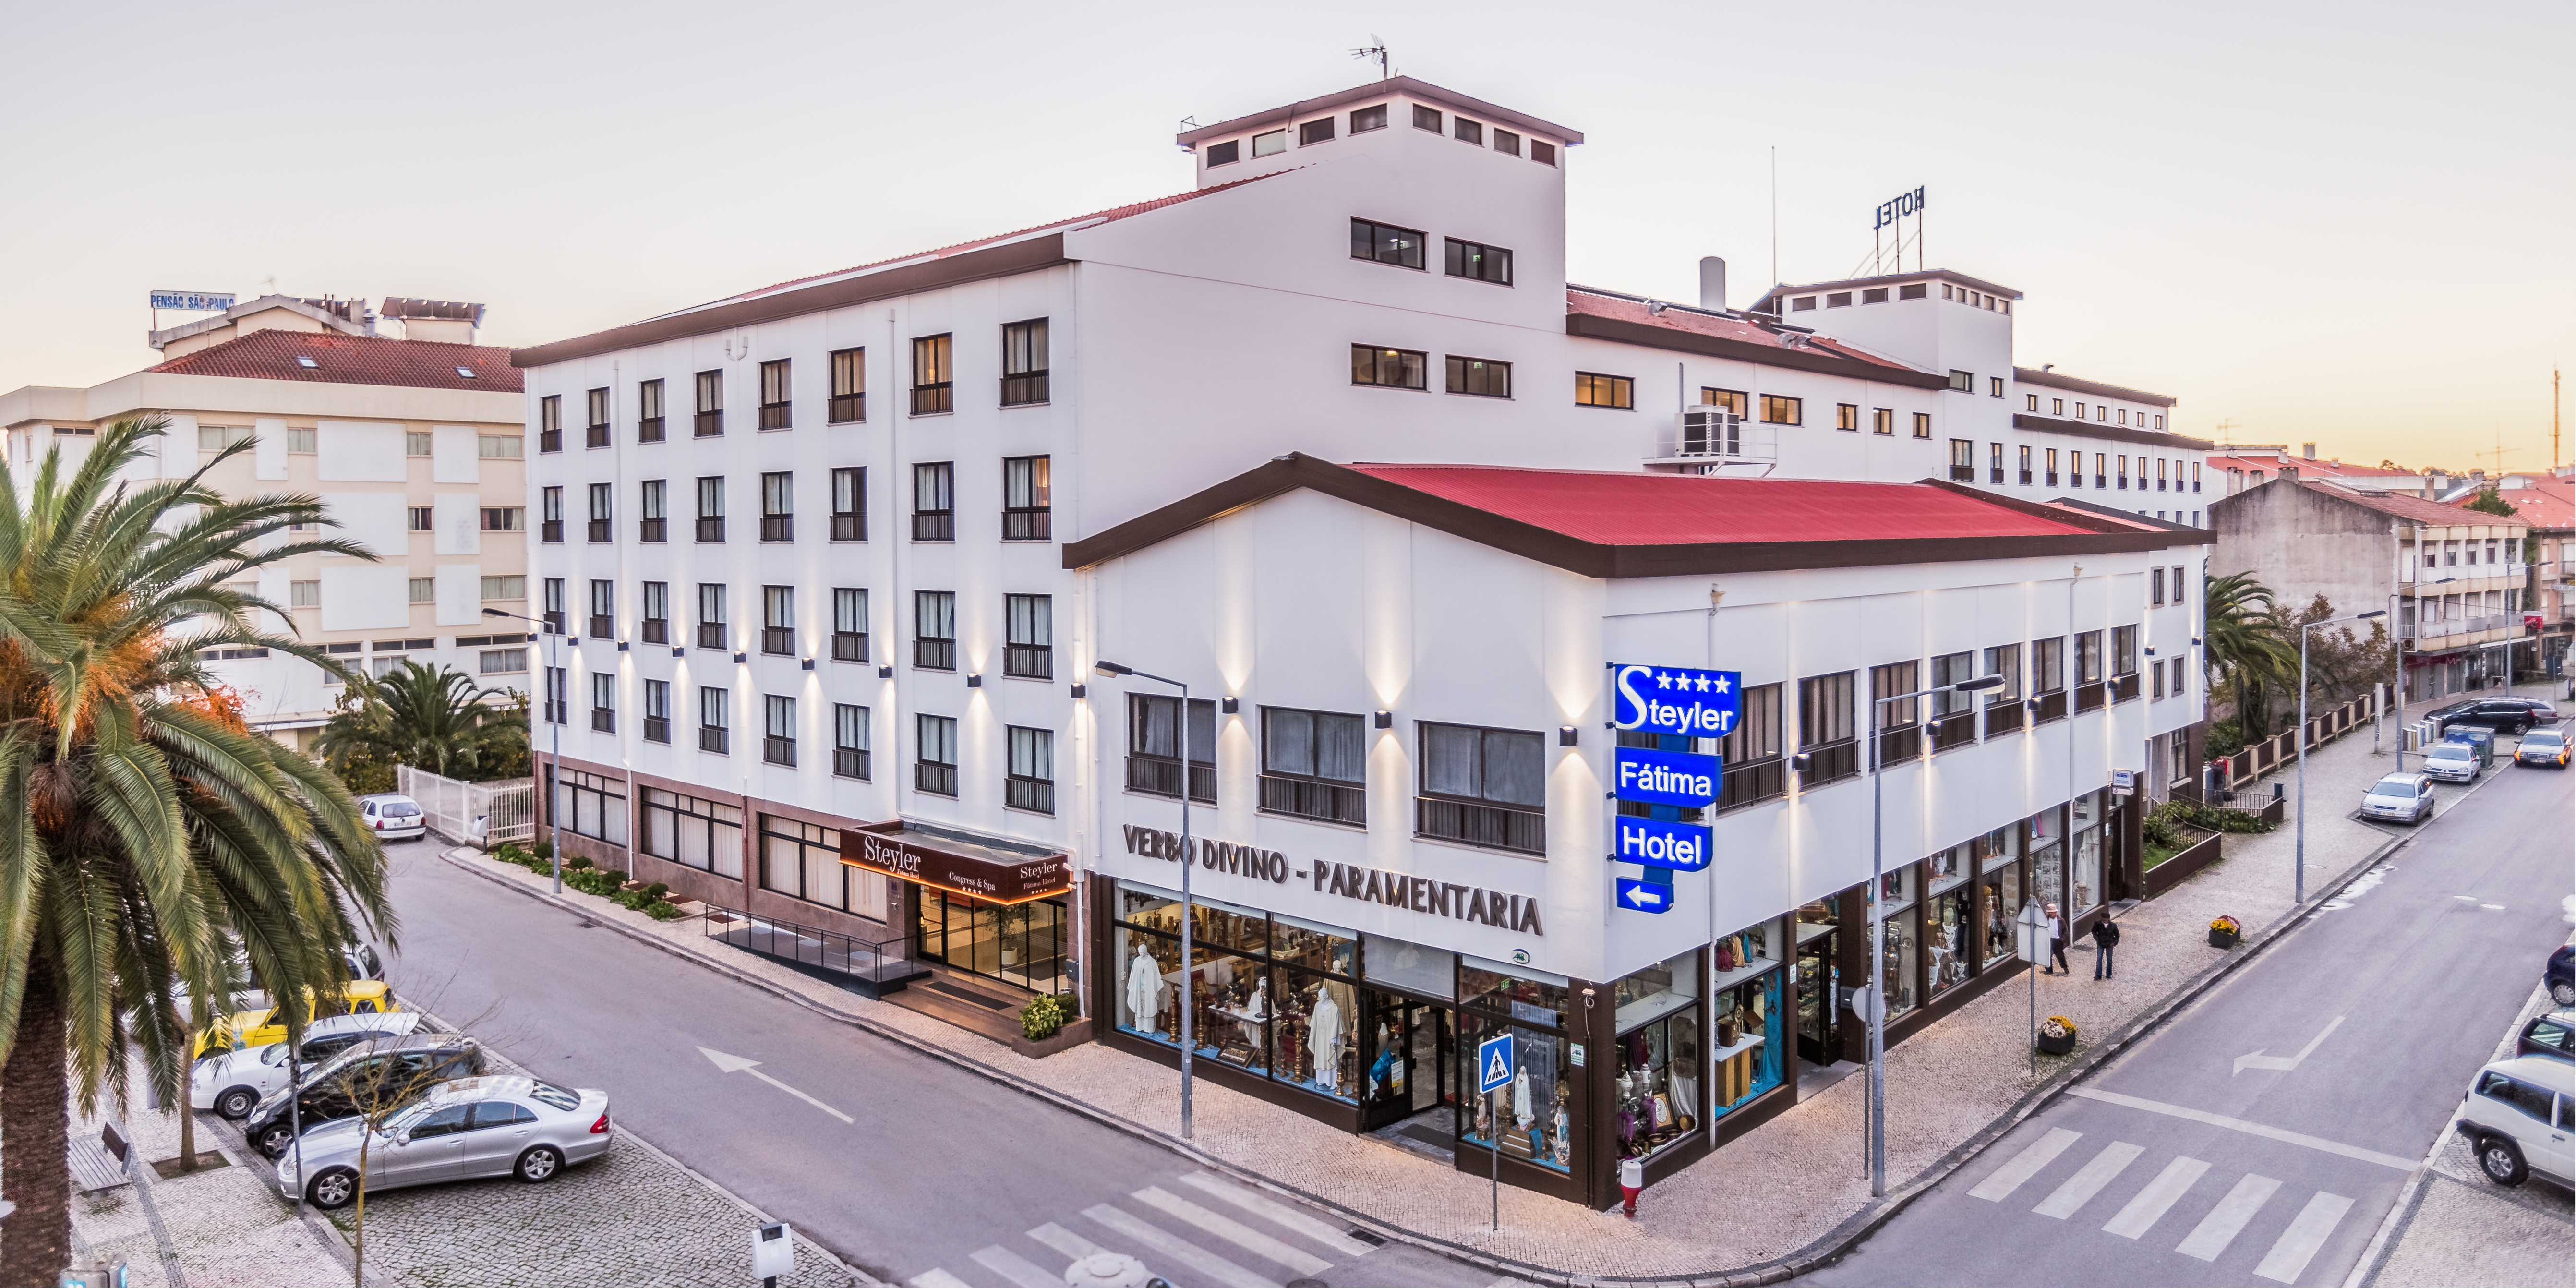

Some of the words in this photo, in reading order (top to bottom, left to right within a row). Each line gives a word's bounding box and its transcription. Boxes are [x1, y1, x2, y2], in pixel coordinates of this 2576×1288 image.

[151, 293, 183, 308] PENSÃO
[188, 294, 205, 309] SÃO
[209, 297, 234, 310] PAULO
[1615, 665, 1734, 734] Steyler
[1621, 761, 1712, 796] Fátima
[865, 836, 921, 872] Steyler
[1623, 825, 1702, 864] Hotel
[949, 871, 976, 886] Congress
[977, 878, 983, 888] &
[983, 879, 996, 892] Spa
[1020, 862, 1058, 879] Steyler
[1023, 881, 1041, 890] Fátima
[1042, 877, 1056, 885] Hotel
[1123, 823, 1197, 865] VERBO
[1202, 838, 1289, 884] DIVINO
[1296, 869, 1307, 878] -
[1314, 858, 1544, 936] PARAMENTARIA
